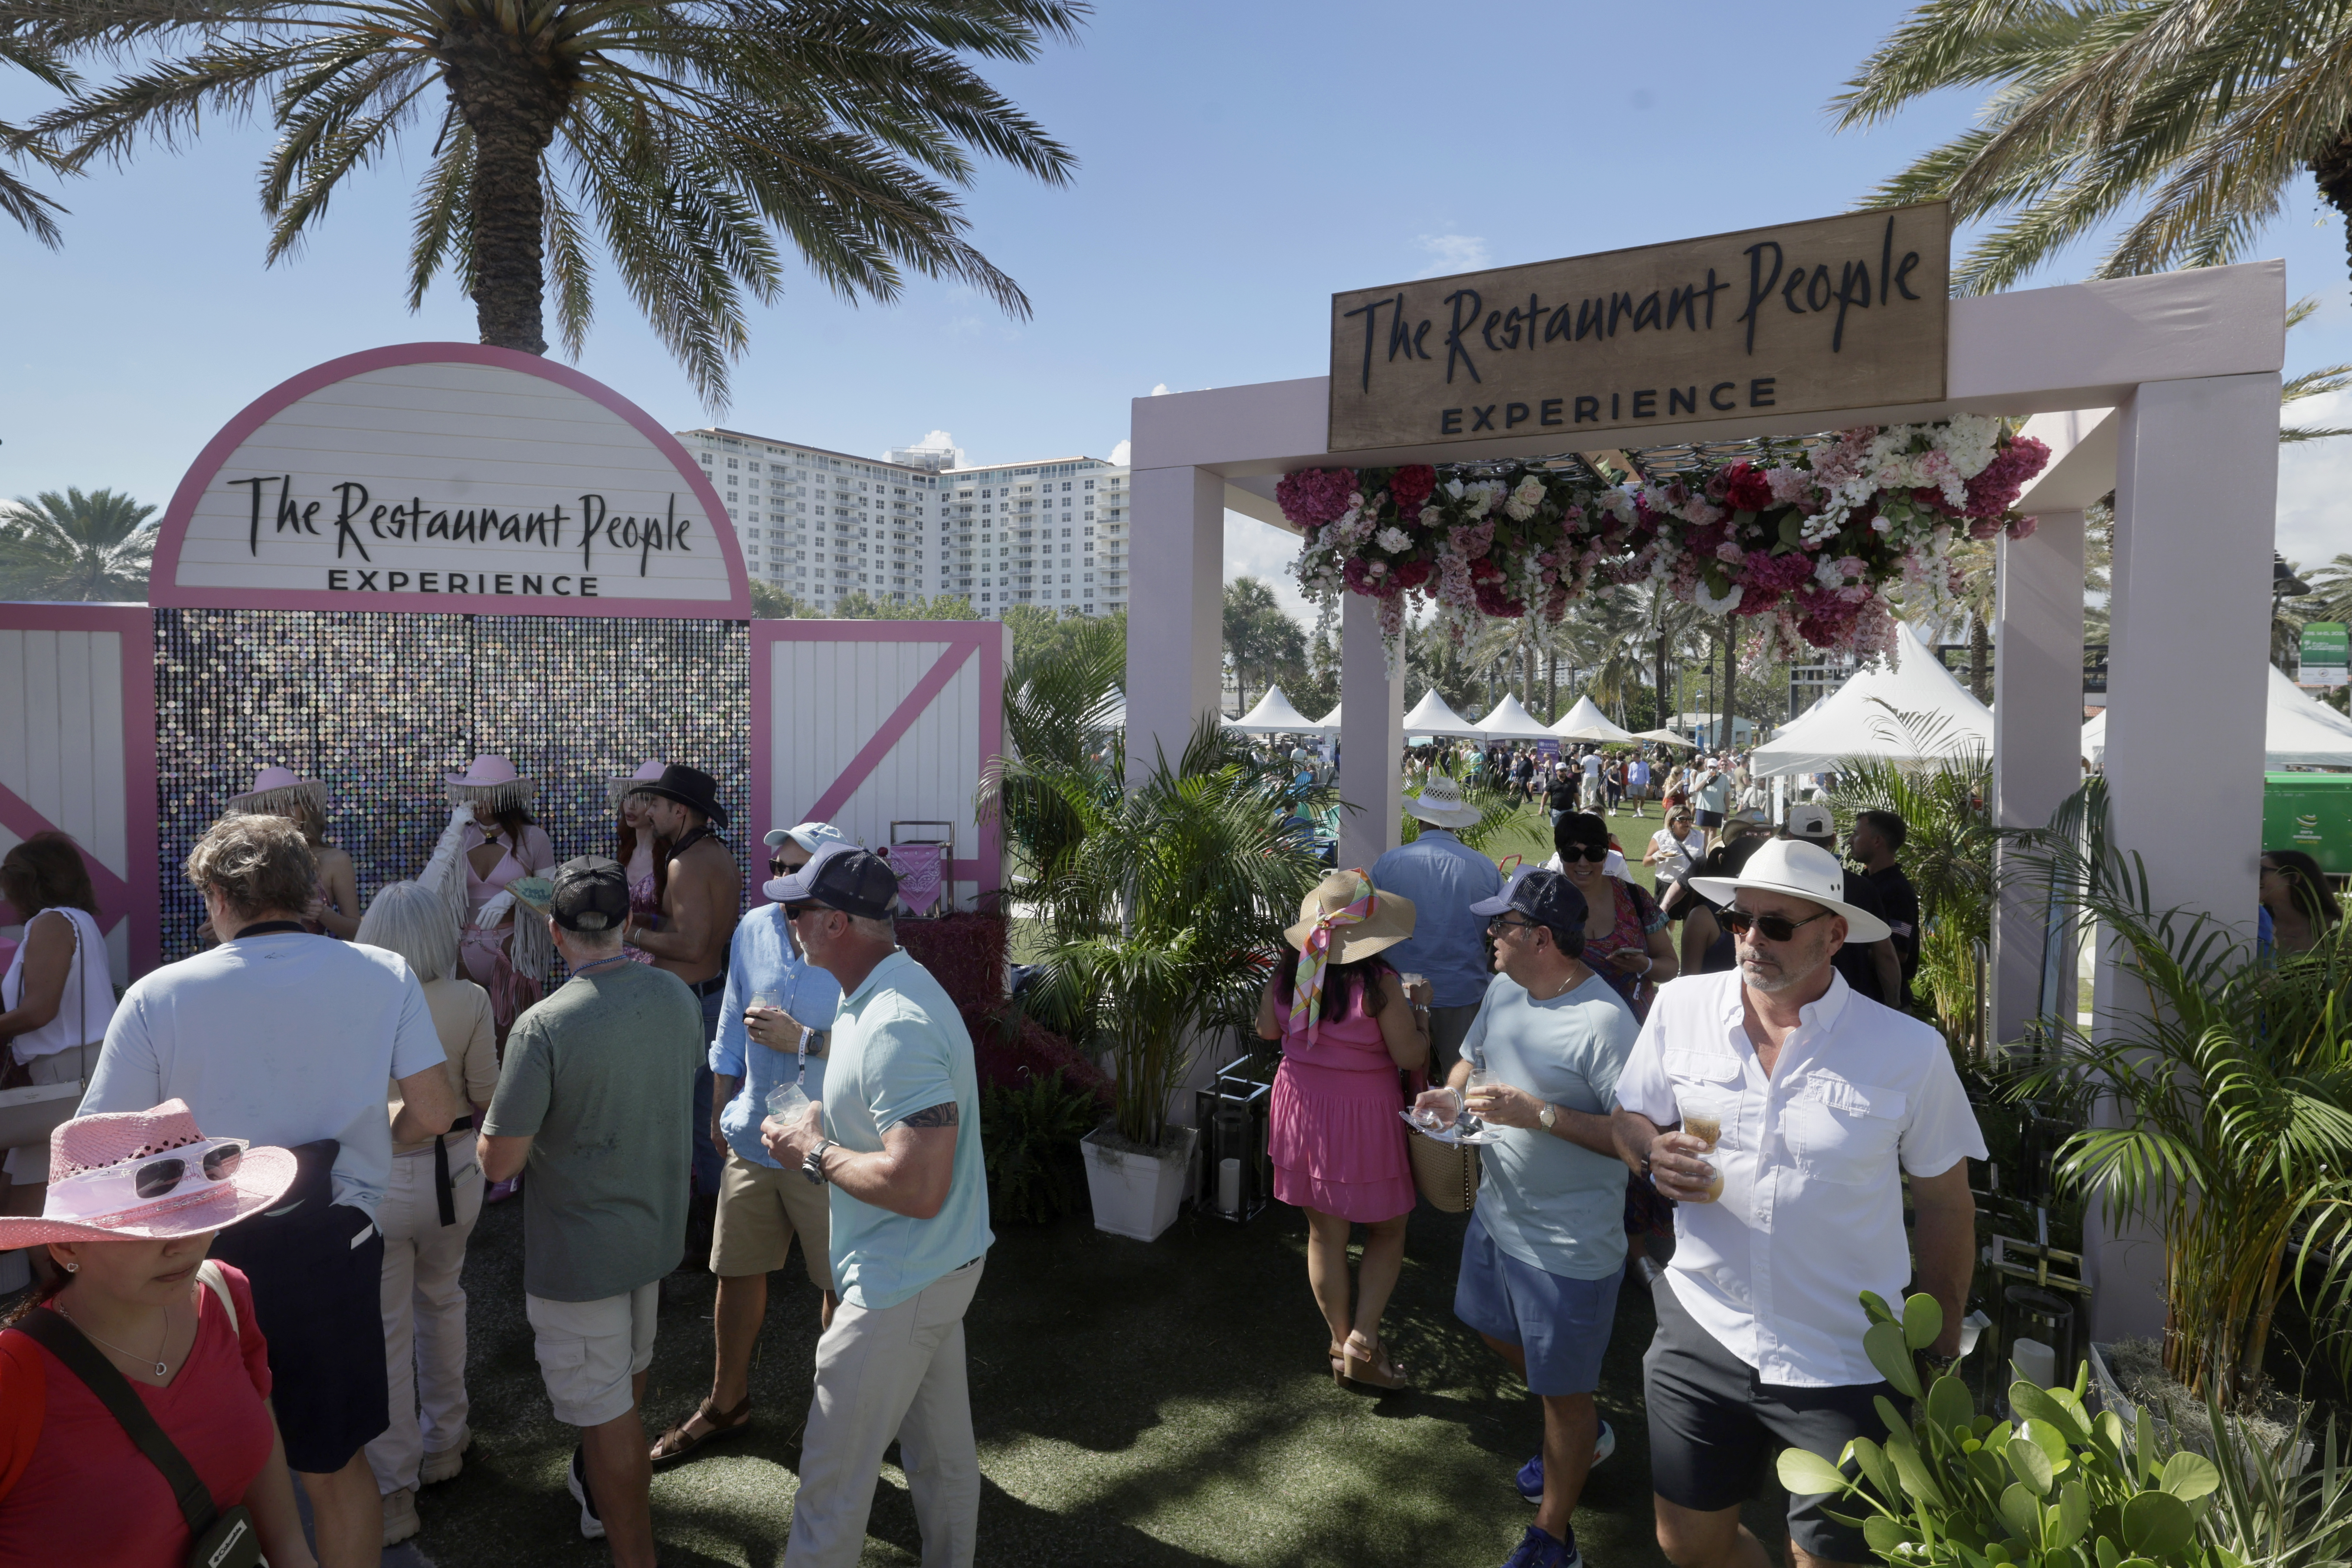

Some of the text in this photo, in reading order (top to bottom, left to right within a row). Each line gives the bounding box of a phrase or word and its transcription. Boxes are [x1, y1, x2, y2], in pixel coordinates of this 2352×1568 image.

[1343, 215, 1922, 396] The Restaurant People
[1440, 377, 1777, 435] EXPERIENCE
[226, 474, 691, 578] The Restaurant People
[328, 569, 598, 597] EXPERIENCE
[219, 1526, 242, 1556] Columbia
